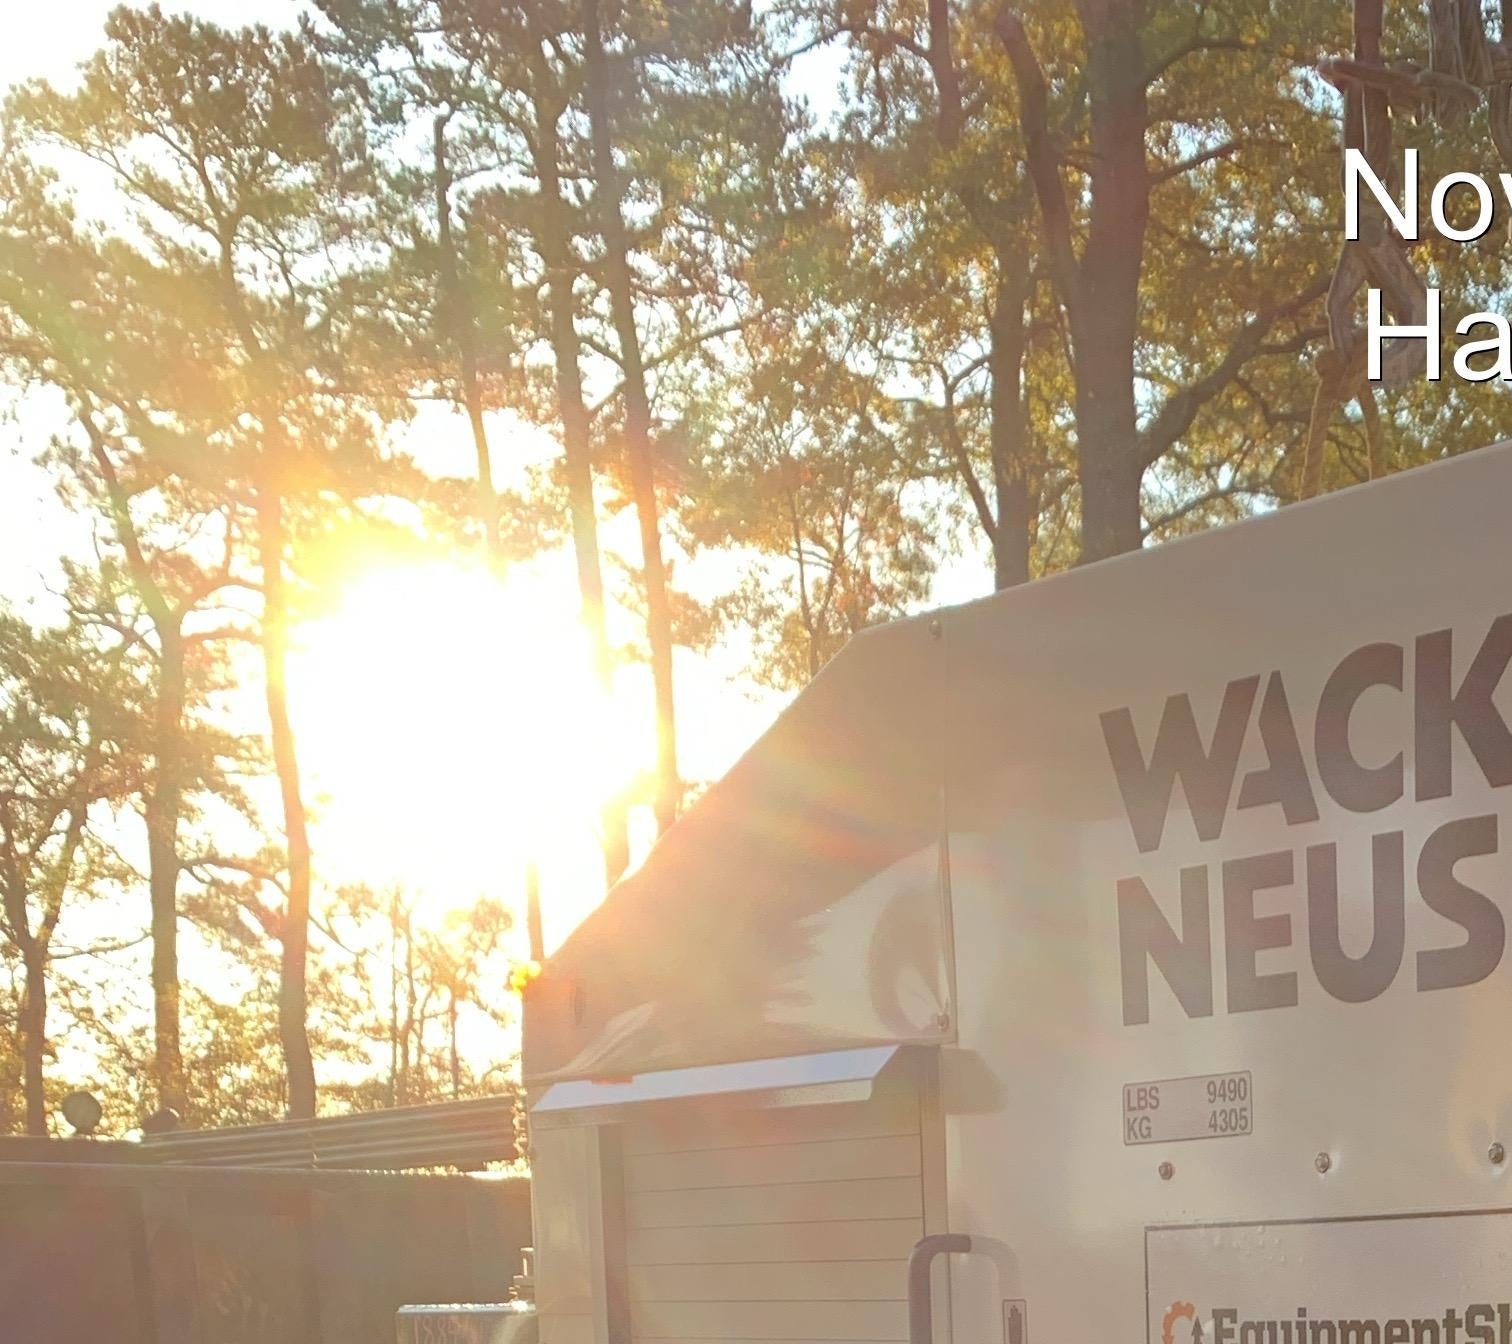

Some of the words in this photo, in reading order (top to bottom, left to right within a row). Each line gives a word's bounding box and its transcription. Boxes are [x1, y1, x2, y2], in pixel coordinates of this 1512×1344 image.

[1126, 1085, 1160, 1112] LBS
[1206, 1077, 1248, 1104] 9490
[1126, 1115, 1152, 1141] KG
[1207, 1107, 1249, 1133] 4305
